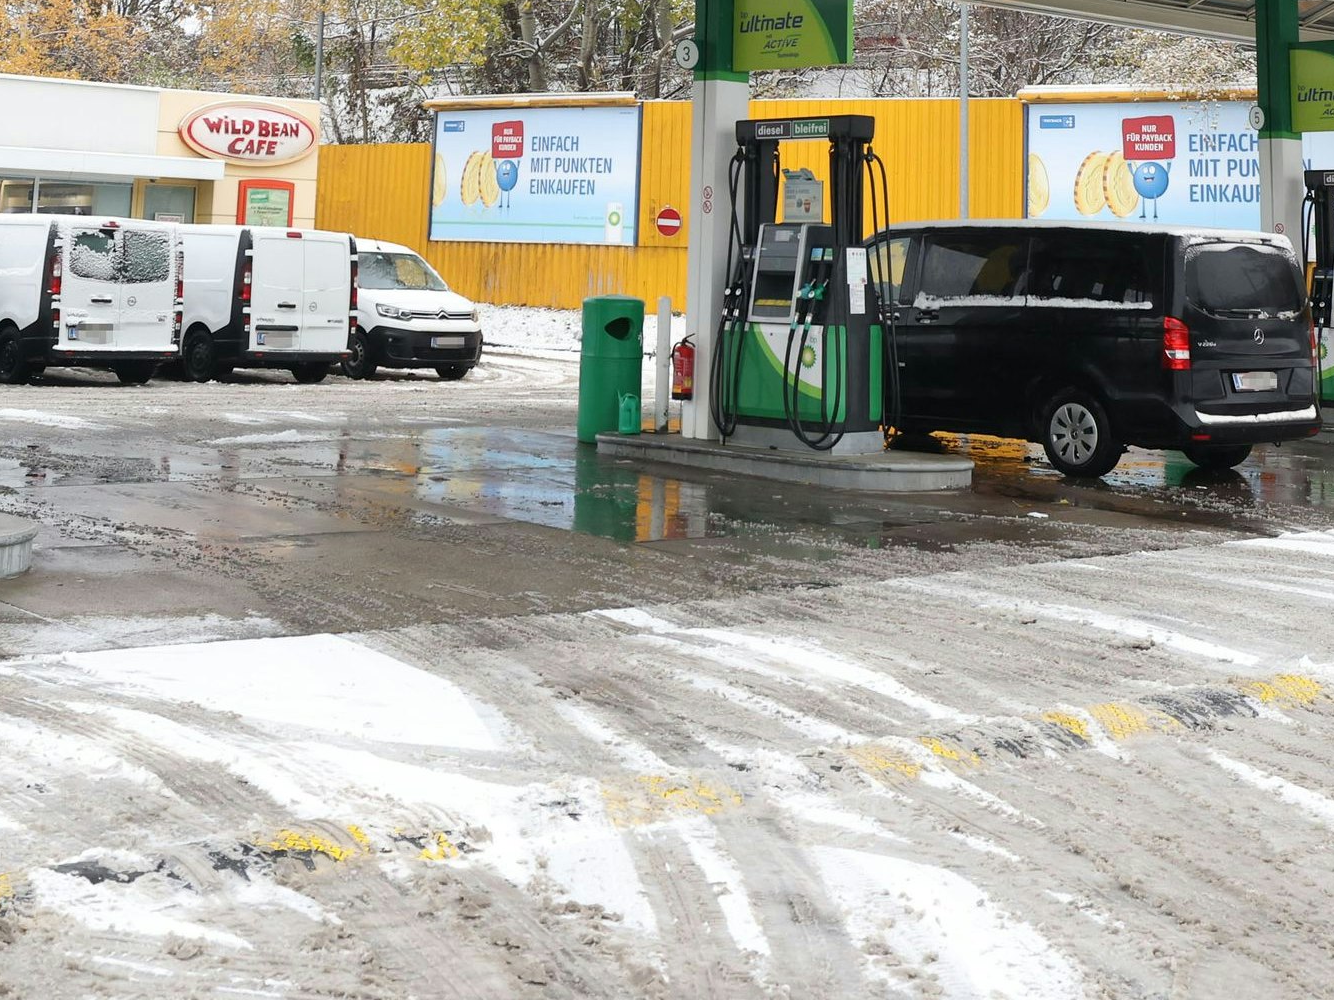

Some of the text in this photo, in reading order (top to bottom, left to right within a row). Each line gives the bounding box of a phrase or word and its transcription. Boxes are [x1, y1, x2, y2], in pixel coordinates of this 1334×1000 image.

[740, 11, 804, 33] ultimate
[763, 38, 799, 50] ACTIVE
[682, 46, 691, 62] 3
[1254, 111, 1261, 124] 5
[258, 119, 300, 138] BEAN
[758, 122, 827, 136] diesel bleifrei
[1141, 124, 1157, 133] NUR
[503, 135, 523, 144] PAYBACK
[531, 136, 580, 152] EINFACH
[1126, 131, 1173, 143] FÜR PAYBACK
[227, 137, 279, 156] CAFE
[1135, 142, 1164, 152] KUNDEN
[530, 158, 613, 174] MIT PUNKTEN
[1189, 159, 1218, 178] MIT
[529, 179, 596, 195] EINKAUFEN
[1189, 184, 1260, 203] EINKAU
